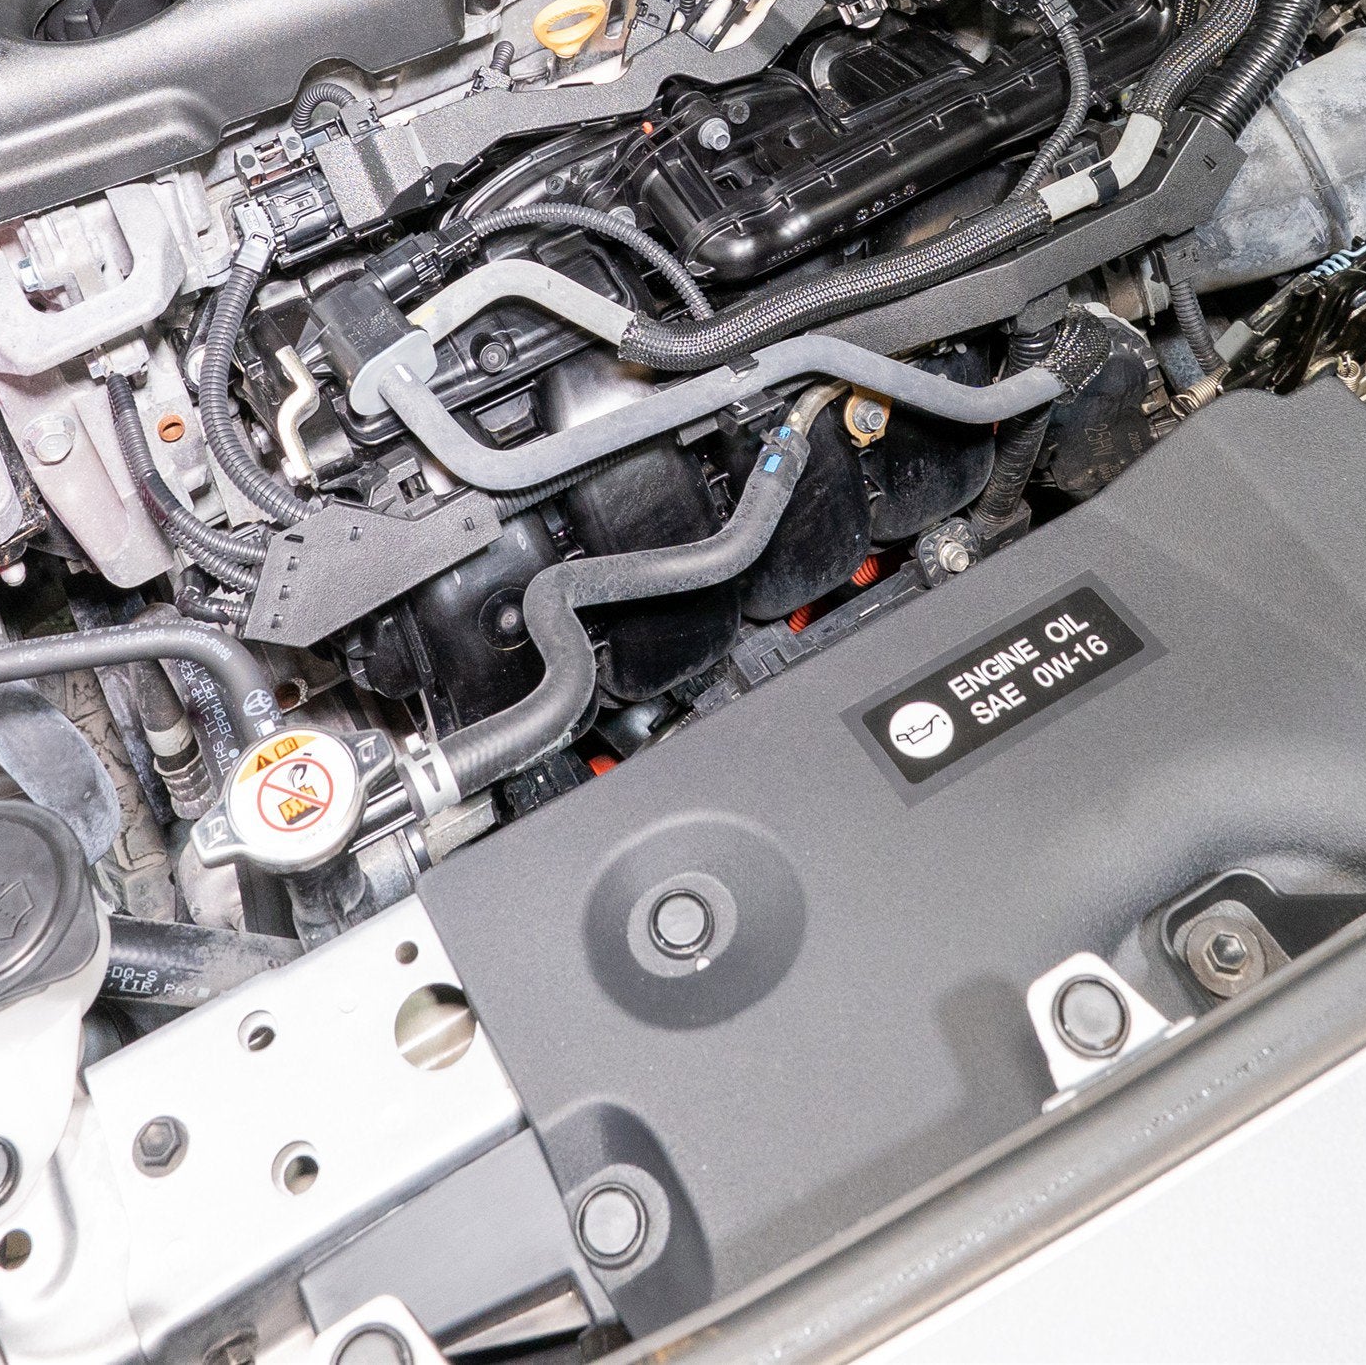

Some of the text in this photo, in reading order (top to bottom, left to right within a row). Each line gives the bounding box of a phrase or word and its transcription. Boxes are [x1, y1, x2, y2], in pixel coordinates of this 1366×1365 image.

[947, 613, 1090, 701] ENGINE OIL
[970, 635, 1109, 725] SAE 0W-16
